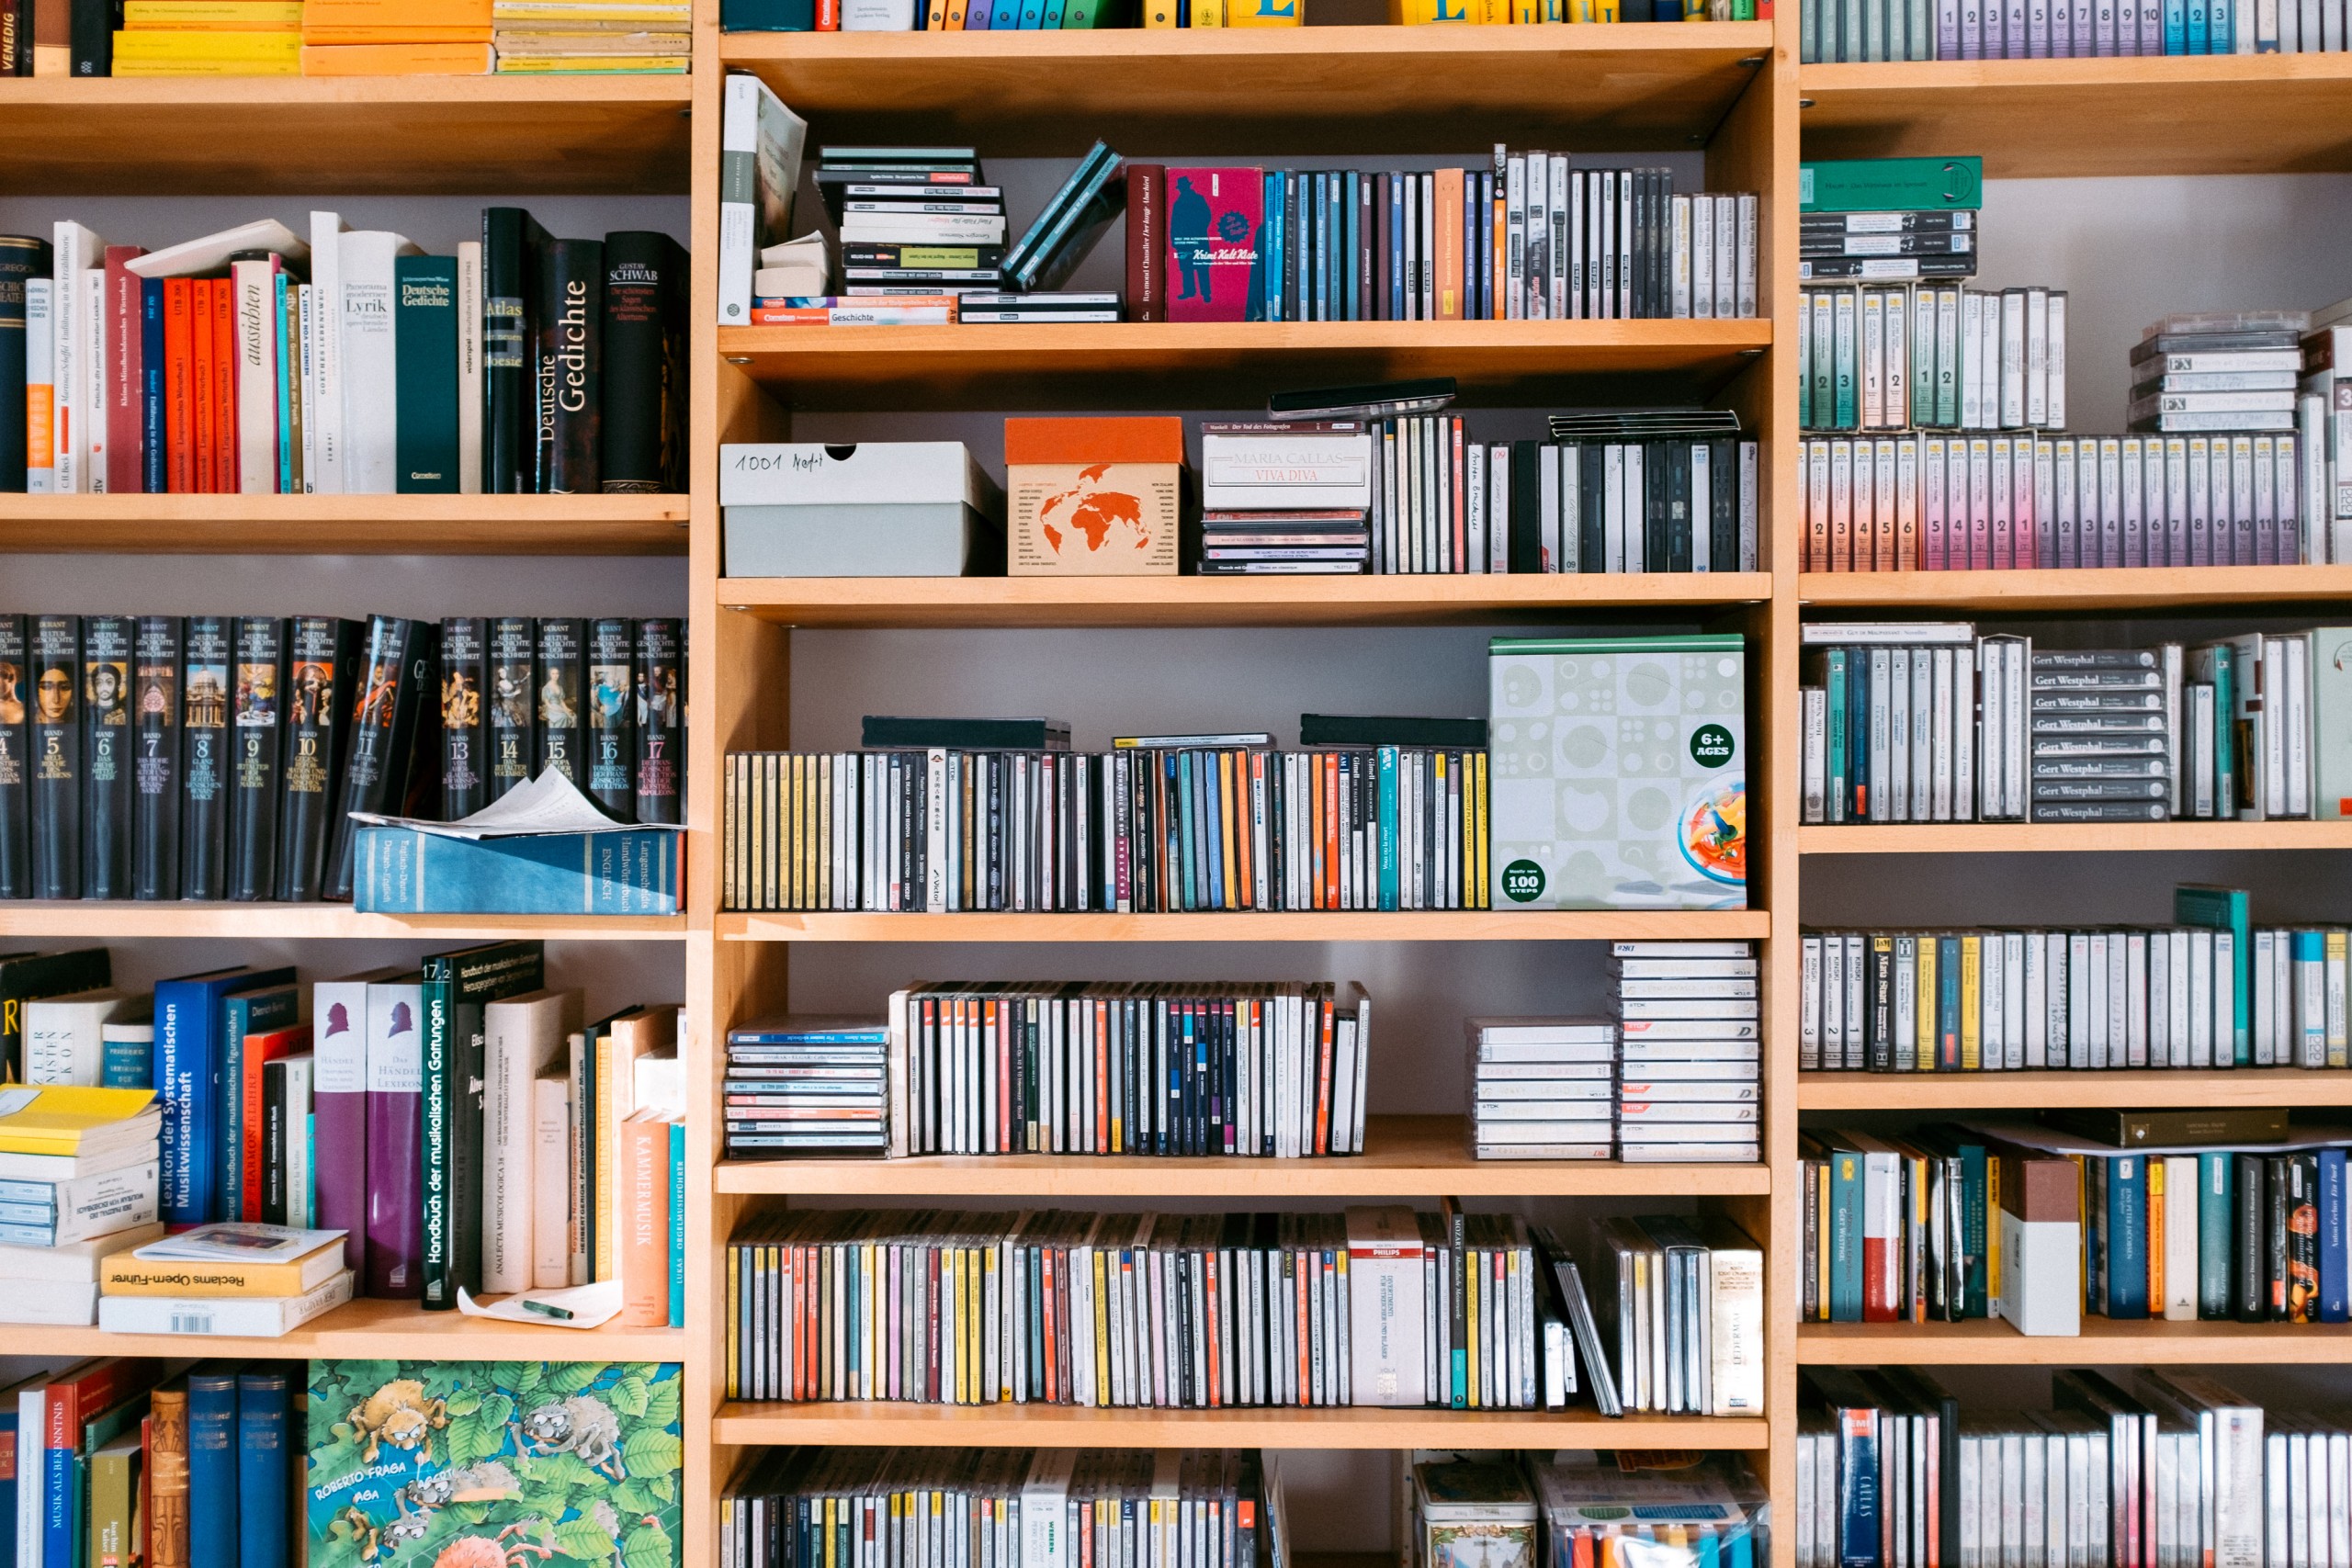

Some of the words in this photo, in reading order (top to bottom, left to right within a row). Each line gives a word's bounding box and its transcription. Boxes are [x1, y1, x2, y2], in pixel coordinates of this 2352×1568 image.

[1946, 12, 1952, 23] 1
[1968, 12, 1976, 23] 2
[1989, 11, 1997, 22] 3
[2013, 10, 2021, 21] 4
[2034, 10, 2043, 21] 5
[2056, 10, 2065, 21] 6
[2079, 9, 2087, 20] 7
[2101, 10, 2110, 21] 8
[2123, 9, 2132, 21] 9
[2143, 10, 2158, 21] 10
[2174, 12, 2179, 22] 1
[2193, 11, 2201, 21] 2
[2215, 9, 2224, 20] 3
[3, 12, 15, 71] VENEDIG
[1142, 238, 1150, 268] Chandler
[609, 270, 658, 281] SCHWAB
[401, 285, 449, 296] Deutsche
[1142, 270, 1150, 301] Raymond
[287, 292, 296, 311] dtv
[345, 299, 387, 315] Lyrik
[402, 296, 449, 307] Gedichte
[486, 301, 523, 316] Atlas
[831, 313, 874, 321] Geschichte
[241, 285, 261, 366] aussichten
[558, 280, 586, 412] Gedichte
[539, 355, 556, 442] Deutsche
[735, 455, 782, 470] 1001
[1234, 454, 1284, 464] MARIA
[1286, 453, 1343, 464] CALLAS
[1255, 470, 1285, 481] VIVA
[1289, 470, 1318, 481] DIVA
[2172, 520, 2179, 531] 7
[2194, 519, 2202, 529] 8
[2217, 520, 2225, 530] 9
[2238, 520, 2251, 531] 10
[2259, 519, 2272, 530] 11
[2281, 519, 2295, 530] 12
[2032, 655, 2051, 665] Gert
[2052, 655, 2095, 667] Westphal
[2035, 676, 2054, 686] Gert
[2056, 675, 2098, 687] Westphal
[2035, 697, 2054, 707] Gert
[2056, 697, 2099, 709] Westphal
[2037, 719, 2056, 729] Gert
[2058, 719, 2101, 730] Westphal
[47, 738, 59, 755] 5
[1702, 733, 1724, 745] 6+
[2038, 742, 2058, 751] Gert
[2060, 741, 2102, 751] Westphal
[97, 739, 110, 755] 6
[146, 740, 158, 757] 7
[197, 740, 209, 758] 8
[246, 740, 259, 758] 9
[299, 739, 316, 756] 10
[450, 742, 469, 760] 13
[501, 741, 518, 759] 14
[548, 742, 565, 760] 15
[601, 742, 618, 760] 16
[648, 741, 664, 759] 17
[1696, 747, 1729, 756] AGES
[2038, 764, 2058, 773] Gert
[2060, 763, 2102, 775] Westphal
[602, 848, 611, 901] ENGLISCH
[1509, 875, 1539, 888] 100
[229, 1010, 239, 1064] Figurenlehre
[429, 999, 445, 1070] Gattungen
[164, 1004, 177, 1114] Systematischen
[377, 1078, 423, 1089] LEXIKON
[228, 1066, 236, 1125] musikalischen
[428, 1075, 442, 1164] musikalischen
[164, 1121, 174, 1144] der
[176, 1072, 191, 1207] Musikwissenschaft
[227, 1146, 235, 1190] Handbuch
[2123, 1164, 2129, 1173] 7
[163, 1150, 173, 1207] Lexikon
[428, 1168, 442, 1191] der
[636, 1136, 651, 1246] KAMMERMUSIK
[496, 1168, 504, 1230] MUSICOLOGICA
[427, 1195, 442, 1263] Handbuch
[496, 1232, 504, 1276] ANALECTA
[110, 1273, 190, 1287] Opern-Führer
[193, 1276, 244, 1287] Reclams
[53, 1402, 63, 1471] BEKENNTNIS
[53, 1472, 62, 1492] ALS
[315, 1471, 365, 1501] ROBERTO
[368, 1461, 407, 1480] FRAGA
[1860, 1476, 1871, 1517] CALLAS
[53, 1494, 62, 1528] MUSIK
[102, 1528, 110, 1552] Kaiser
